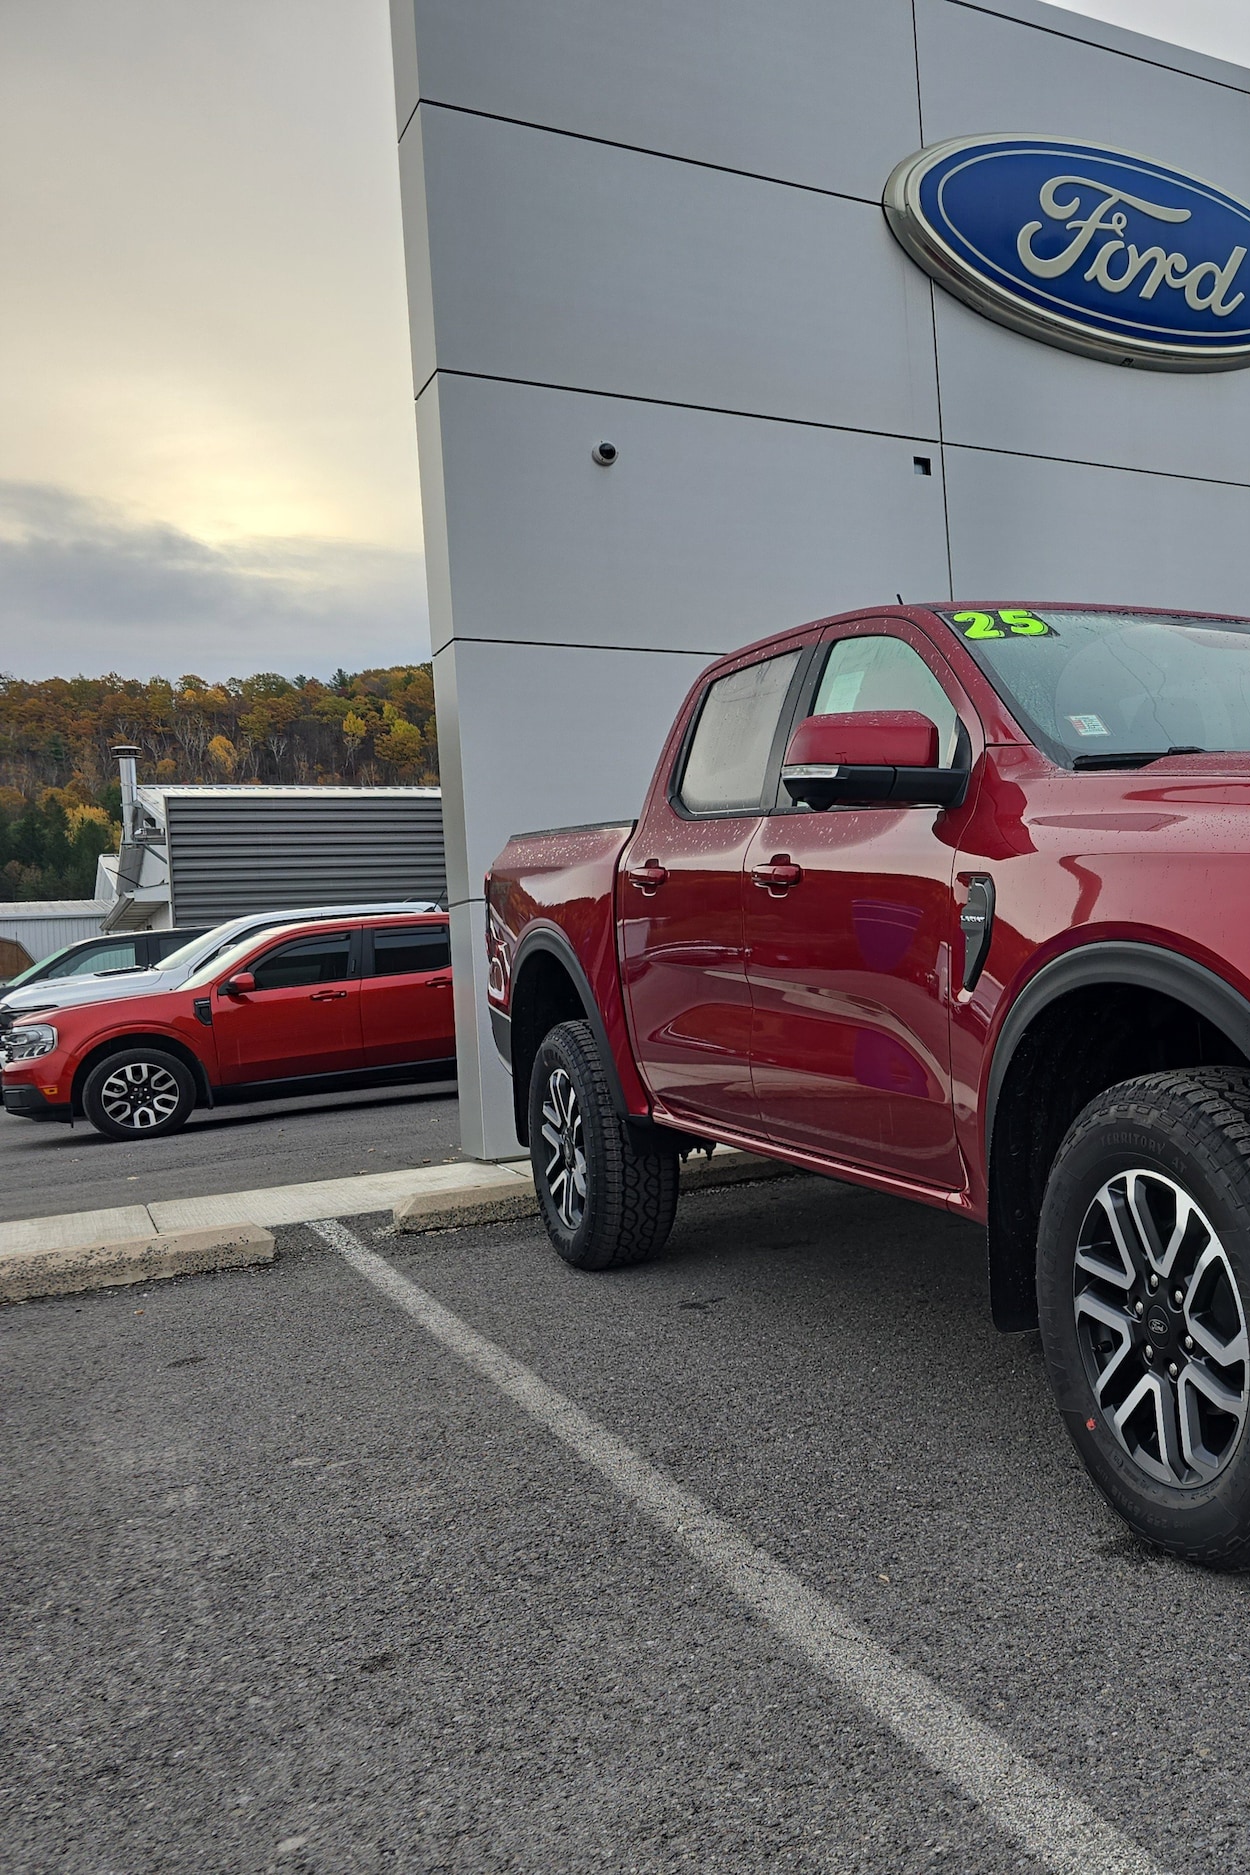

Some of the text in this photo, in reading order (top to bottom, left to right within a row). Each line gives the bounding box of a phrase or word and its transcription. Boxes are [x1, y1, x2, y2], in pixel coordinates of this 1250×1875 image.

[1016, 175, 1248, 317] Ford
[953, 610, 1049, 640] 25
[1099, 1131, 1167, 1156] TERRITORY
